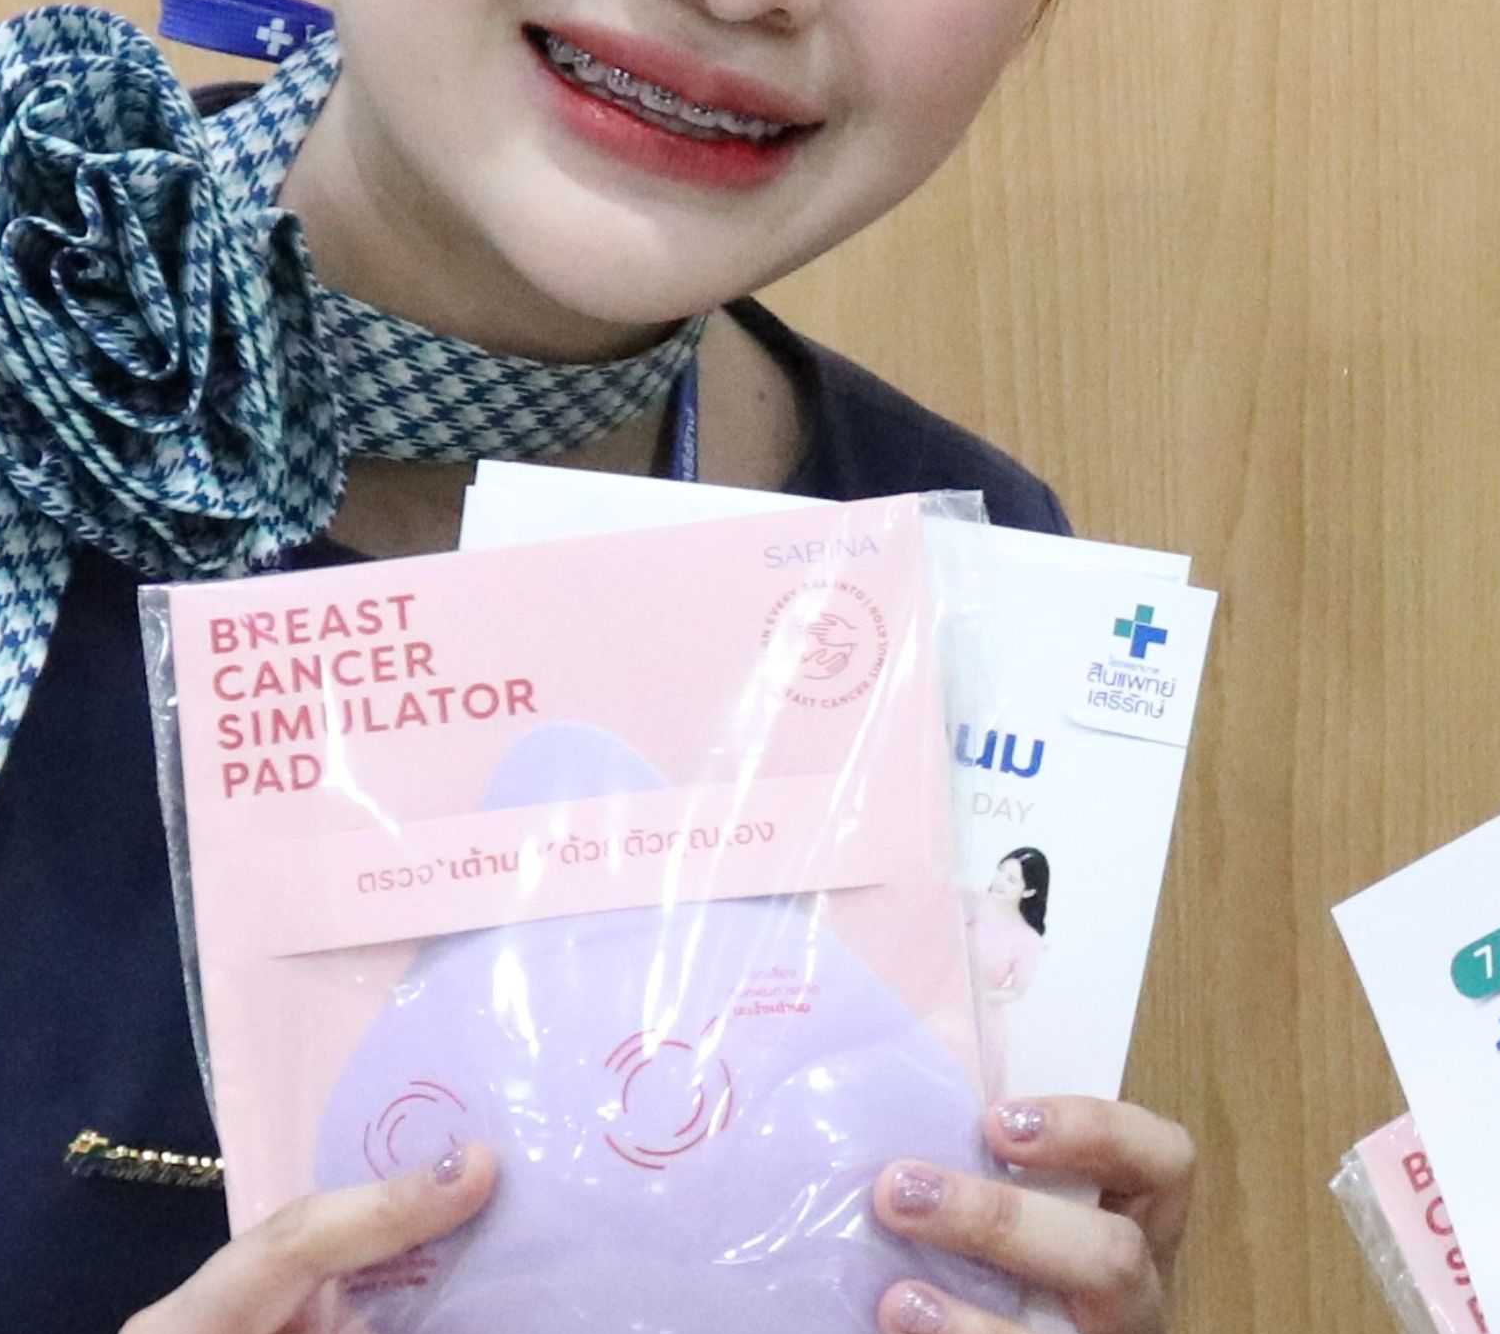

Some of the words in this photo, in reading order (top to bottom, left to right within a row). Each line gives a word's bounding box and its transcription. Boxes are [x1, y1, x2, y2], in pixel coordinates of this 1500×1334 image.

[209, 594, 416, 655] BREAST
[211, 640, 437, 702] CANCER
[216, 678, 538, 751] SIMULATOR
[221, 753, 323, 799] PAD
[971, 791, 1035, 824] DAY
[1473, 944, 1494, 979] 7
